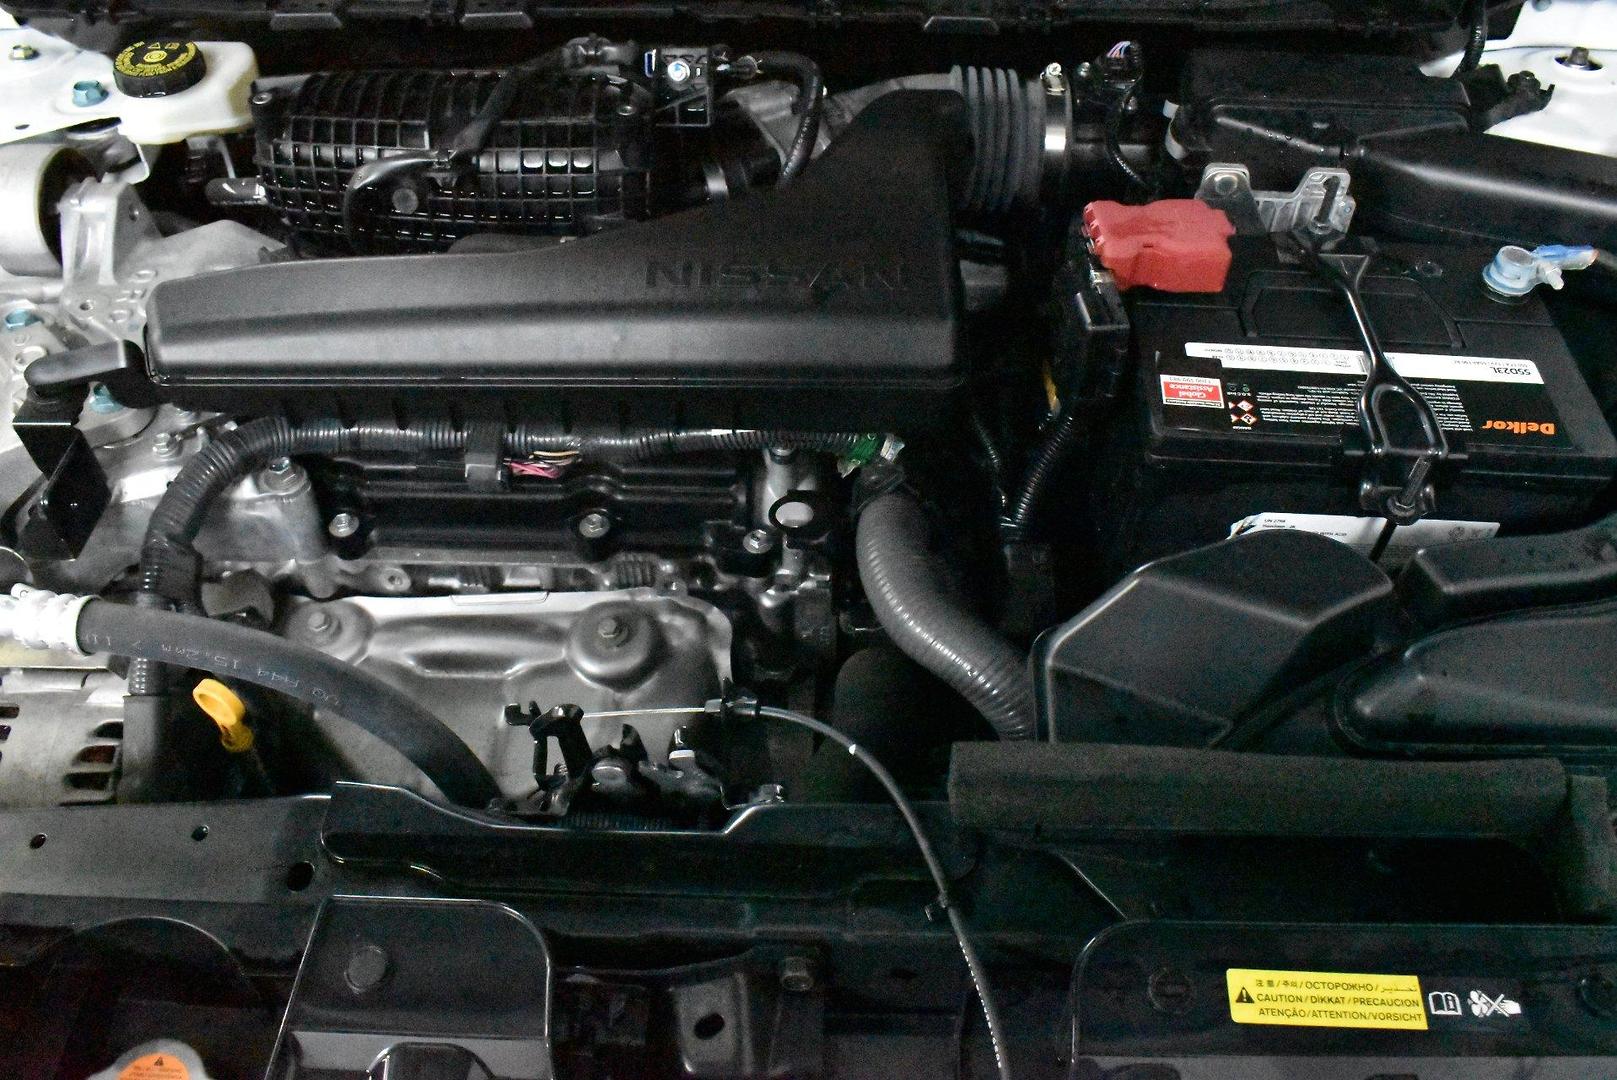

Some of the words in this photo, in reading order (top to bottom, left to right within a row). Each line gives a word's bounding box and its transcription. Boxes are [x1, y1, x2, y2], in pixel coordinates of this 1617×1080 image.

[1169, 383, 1214, 393] Assistance
[1179, 390, 1207, 399] Global
[1481, 420, 1556, 435] Delkor
[1305, 980, 1374, 992] ОСТОРОЖНО
[1256, 993, 1303, 1004] CAUTION
